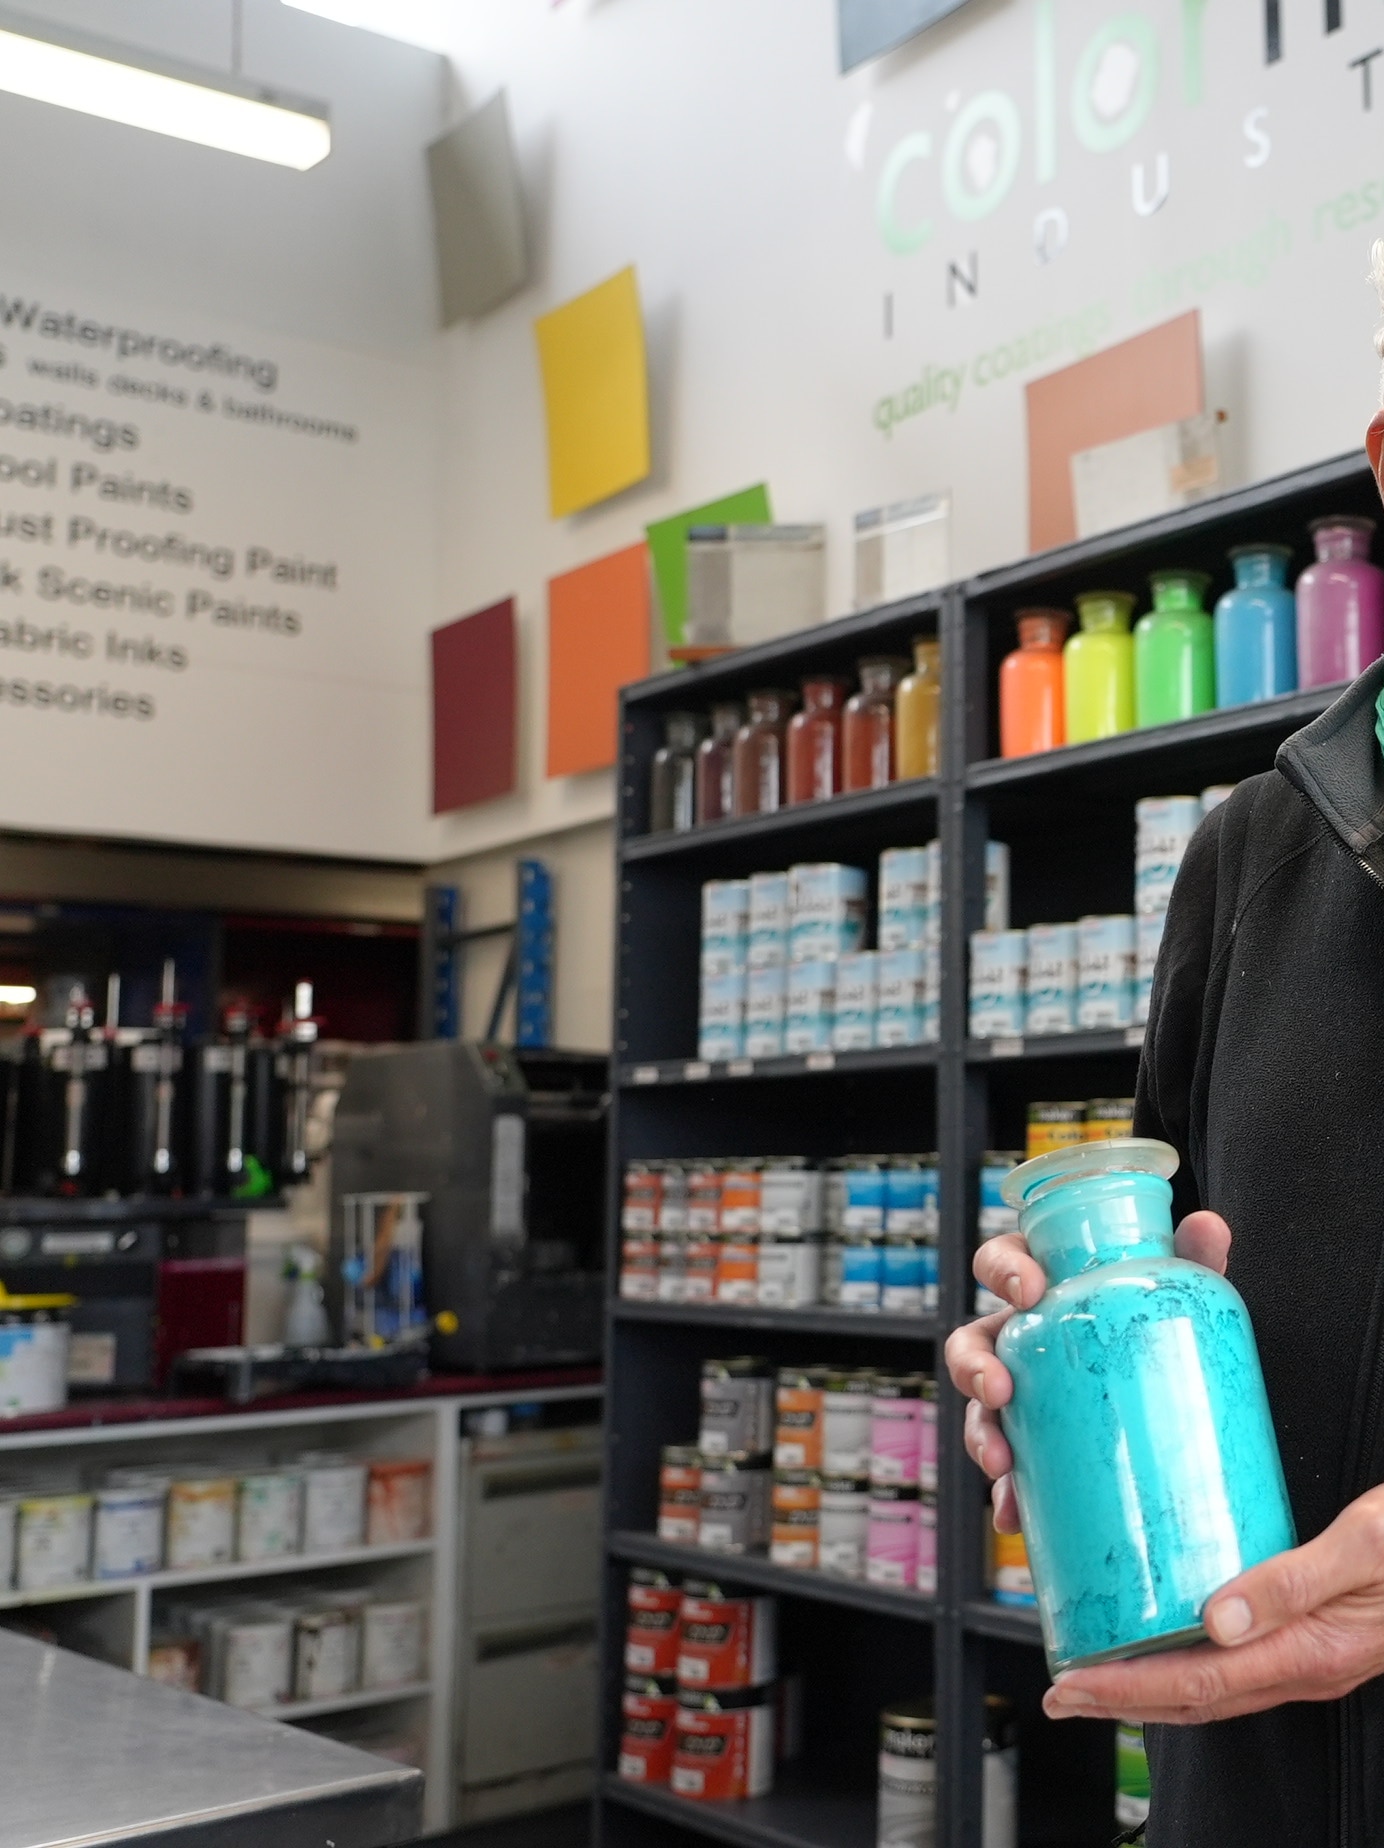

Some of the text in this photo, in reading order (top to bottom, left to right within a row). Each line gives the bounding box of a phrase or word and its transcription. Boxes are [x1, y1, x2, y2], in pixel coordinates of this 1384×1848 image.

[0, 294, 279, 394] Waterproofing
[28, 356, 99, 390] walls
[70, 461, 195, 515] Paints
[67, 515, 235, 582] Proofing
[245, 546, 339, 592] Paint
[37, 564, 175, 619] Scenic
[185, 588, 302, 638] Paints
[105, 628, 190, 673] Inks
